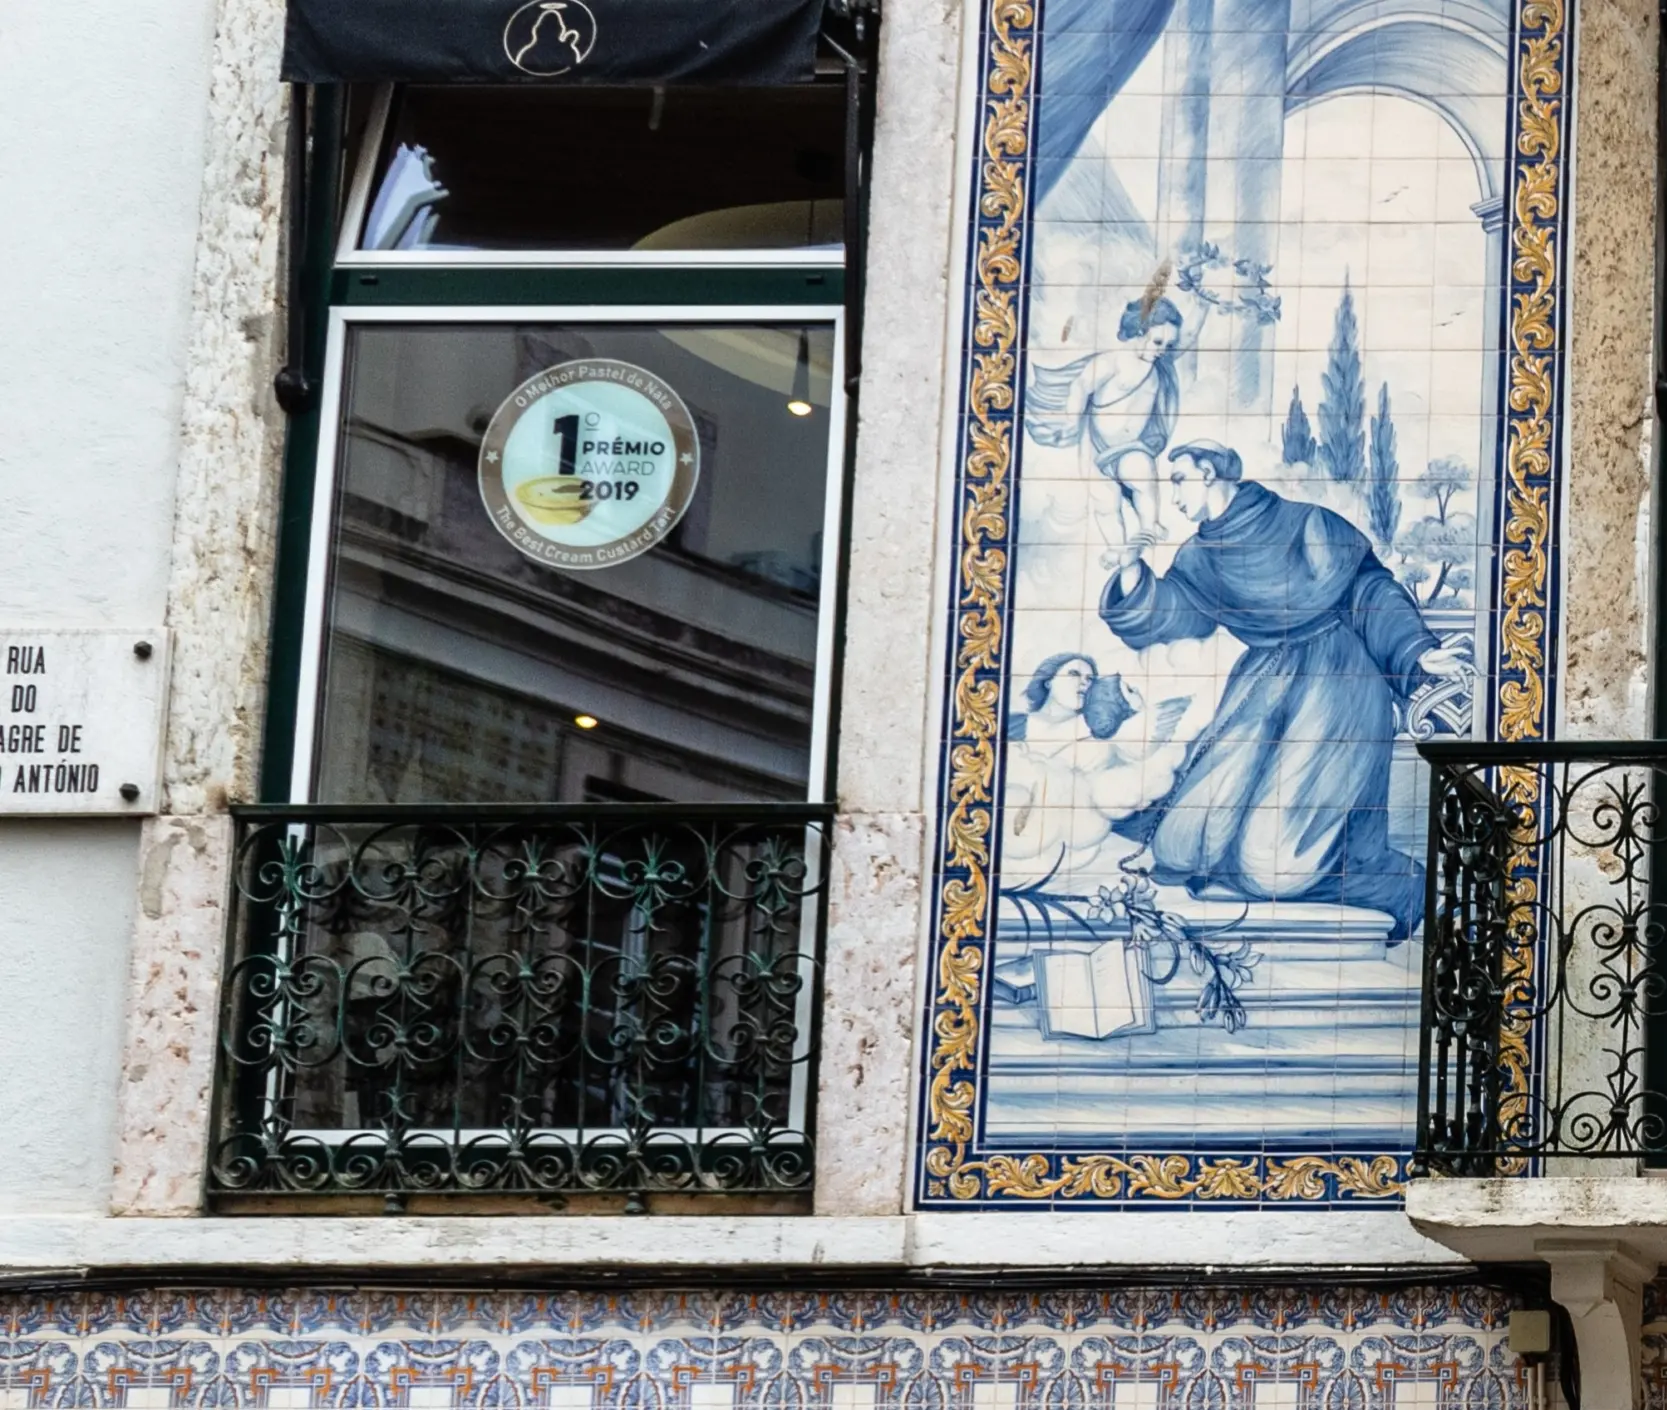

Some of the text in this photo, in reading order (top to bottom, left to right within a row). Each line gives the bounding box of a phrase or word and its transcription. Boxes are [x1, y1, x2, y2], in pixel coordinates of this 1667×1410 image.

[514, 365, 673, 411] O Melhor Pastel de Nata
[582, 437, 665, 456] PRÉMIO
[580, 461, 656, 476] AWARD
[578, 480, 640, 501] 2019
[497, 504, 676, 564] The Best Cream Custard Tart
[7, 646, 46, 674] RUA
[11, 684, 37, 713] DO
[57, 725, 83, 753] DE
[13, 759, 99, 793] ANTÓNIO
